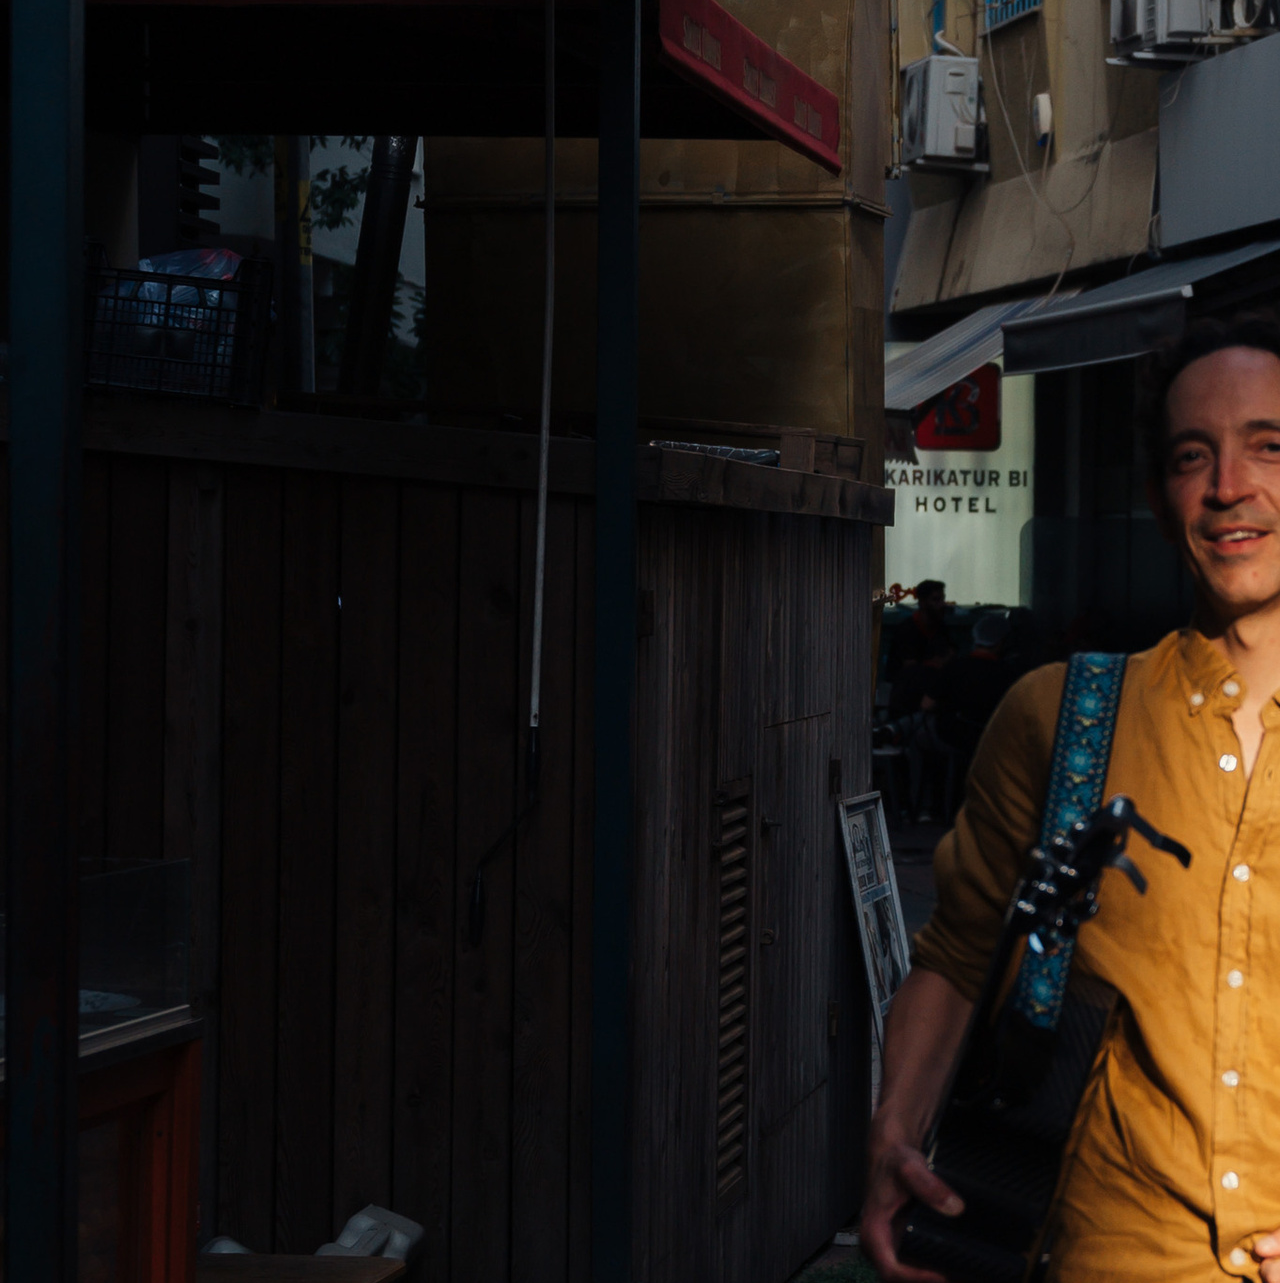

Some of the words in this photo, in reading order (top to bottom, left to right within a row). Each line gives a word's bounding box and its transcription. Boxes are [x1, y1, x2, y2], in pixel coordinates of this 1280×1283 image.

[885, 469, 1000, 487] KARIKATUR
[1009, 470, 1028, 487] BI
[916, 496, 997, 513] HOTEL
